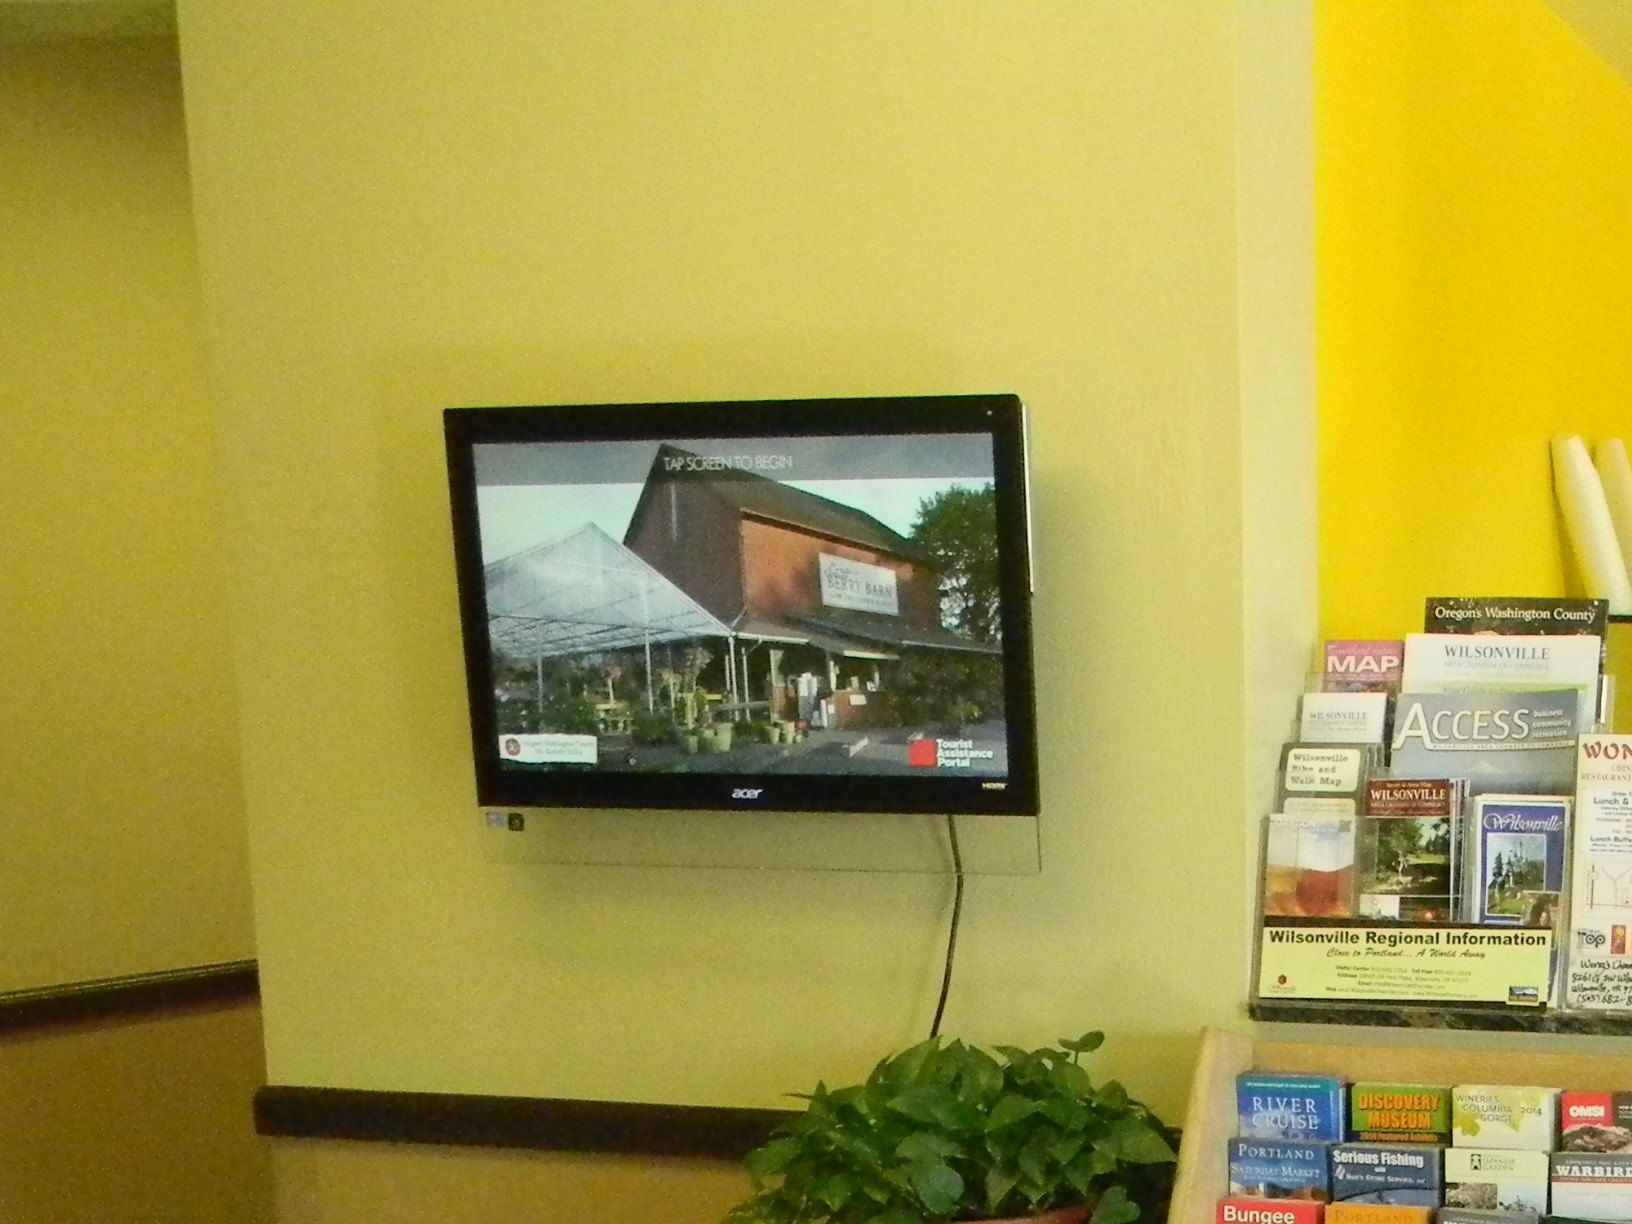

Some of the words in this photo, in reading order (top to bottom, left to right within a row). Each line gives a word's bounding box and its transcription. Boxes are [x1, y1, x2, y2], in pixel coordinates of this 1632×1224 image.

[664, 457, 684, 471] TAP
[687, 456, 731, 470] SCREEN
[734, 455, 750, 469] TO
[755, 455, 794, 469] BEGIN
[1434, 606, 1483, 620] Oregon's
[1485, 607, 1551, 621] Washington
[1553, 608, 1596, 623] County
[1444, 644, 1551, 661] WILSONVILLE
[1326, 655, 1400, 674] MAP
[1391, 702, 1531, 750] ACCESS
[936, 739, 973, 749] Tourist
[936, 749, 993, 759] Assistance
[1293, 753, 1349, 763] Wilsonville
[937, 758, 971, 768] Portal
[1318, 765, 1336, 774] and
[1290, 776, 1315, 785] Walk
[1319, 777, 1342, 787] Map
[731, 788, 763, 799] acer
[1370, 789, 1446, 800] WILSONVILLE
[1593, 797, 1619, 805] Lunch
[1482, 813, 1565, 832] Wilsonville
[1270, 931, 1360, 944] Wilsonville
[1365, 932, 1440, 947] Regional
[1446, 932, 1546, 946] Information
[1326, 948, 1351, 958] Close
[1428, 948, 1457, 958] World
[1459, 950, 1486, 959] Away
[1252, 1097, 1317, 1113] RIVER
[1359, 1094, 1440, 1111] DISCOVERY
[1455, 1095, 1499, 1103] WINERIES
[1462, 1104, 1512, 1113] COLUMBIA
[1252, 1112, 1319, 1130] CRUISE
[1368, 1112, 1431, 1129] MUSEUM
[1480, 1114, 1514, 1123] GORGE
[1238, 1144, 1314, 1160] PORTLAND
[1332, 1150, 1379, 1165] Serious
[1381, 1152, 1424, 1168] Fishing
[1224, 1205, 1295, 1224] Bungee
